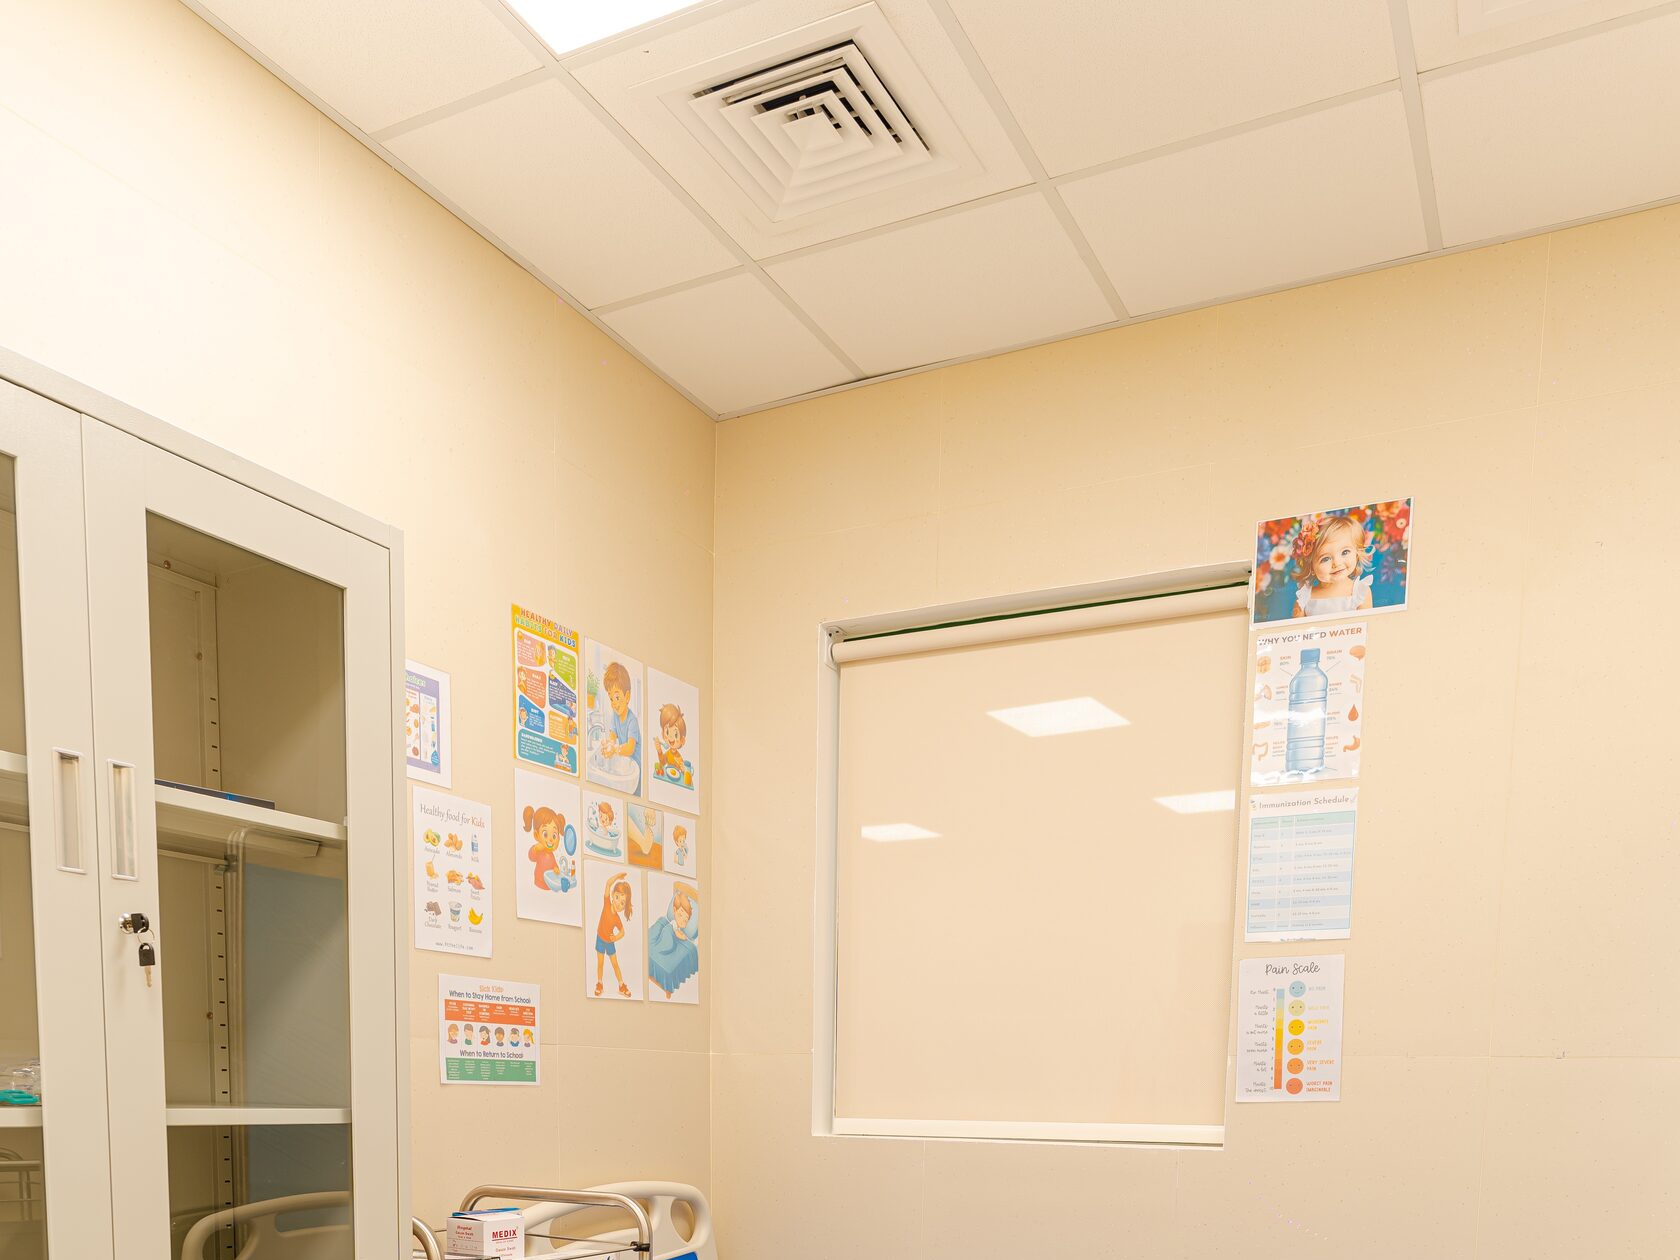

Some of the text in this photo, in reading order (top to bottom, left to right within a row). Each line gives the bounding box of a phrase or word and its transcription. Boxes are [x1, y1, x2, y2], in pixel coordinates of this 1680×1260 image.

[520, 607, 573, 636] HEALTHY DAILY
[515, 615, 577, 648] HABITS FOR KIDS
[1303, 631, 1327, 641] NED
[1329, 627, 1362, 638] WATER
[1259, 795, 1350, 809] Immunization Schedule
[420, 803, 485, 828] Healthy food for Kids
[1264, 961, 1320, 976] Pain Scale
[449, 990, 465, 998] When
[472, 992, 484, 1001] Stay
[484, 993, 500, 1002] Home
[501, 995, 514, 1003] from
[514, 996, 531, 1004] School
[460, 1049, 476, 1057] When
[483, 1050, 500, 1058] Return
[492, 1229, 517, 1239] MEDIX
